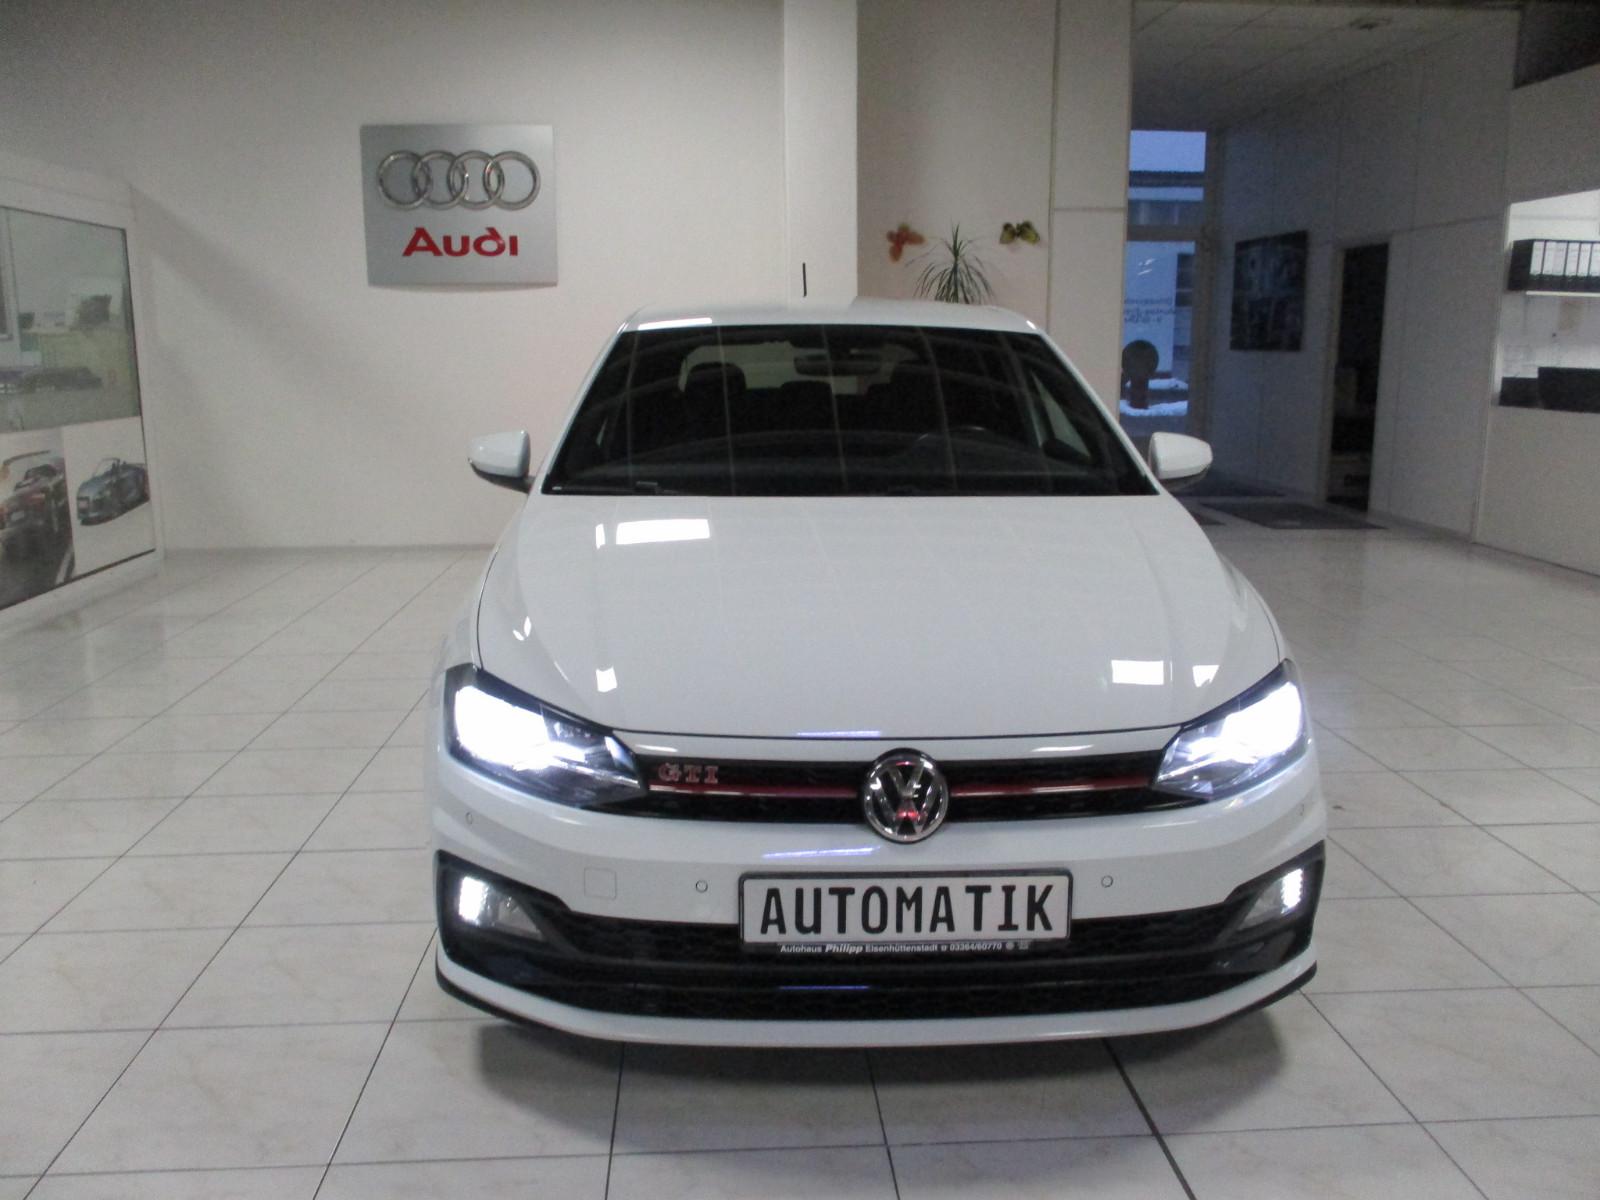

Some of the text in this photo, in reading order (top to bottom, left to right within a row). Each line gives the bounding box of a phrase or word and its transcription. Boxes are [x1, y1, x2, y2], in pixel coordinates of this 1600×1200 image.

[402, 226, 519, 257] Audi
[658, 762, 719, 785] GTI
[760, 884, 1054, 935] AUTOMATIK
[780, 944, 822, 953] Autohaus
[825, 943, 864, 955] Philipp
